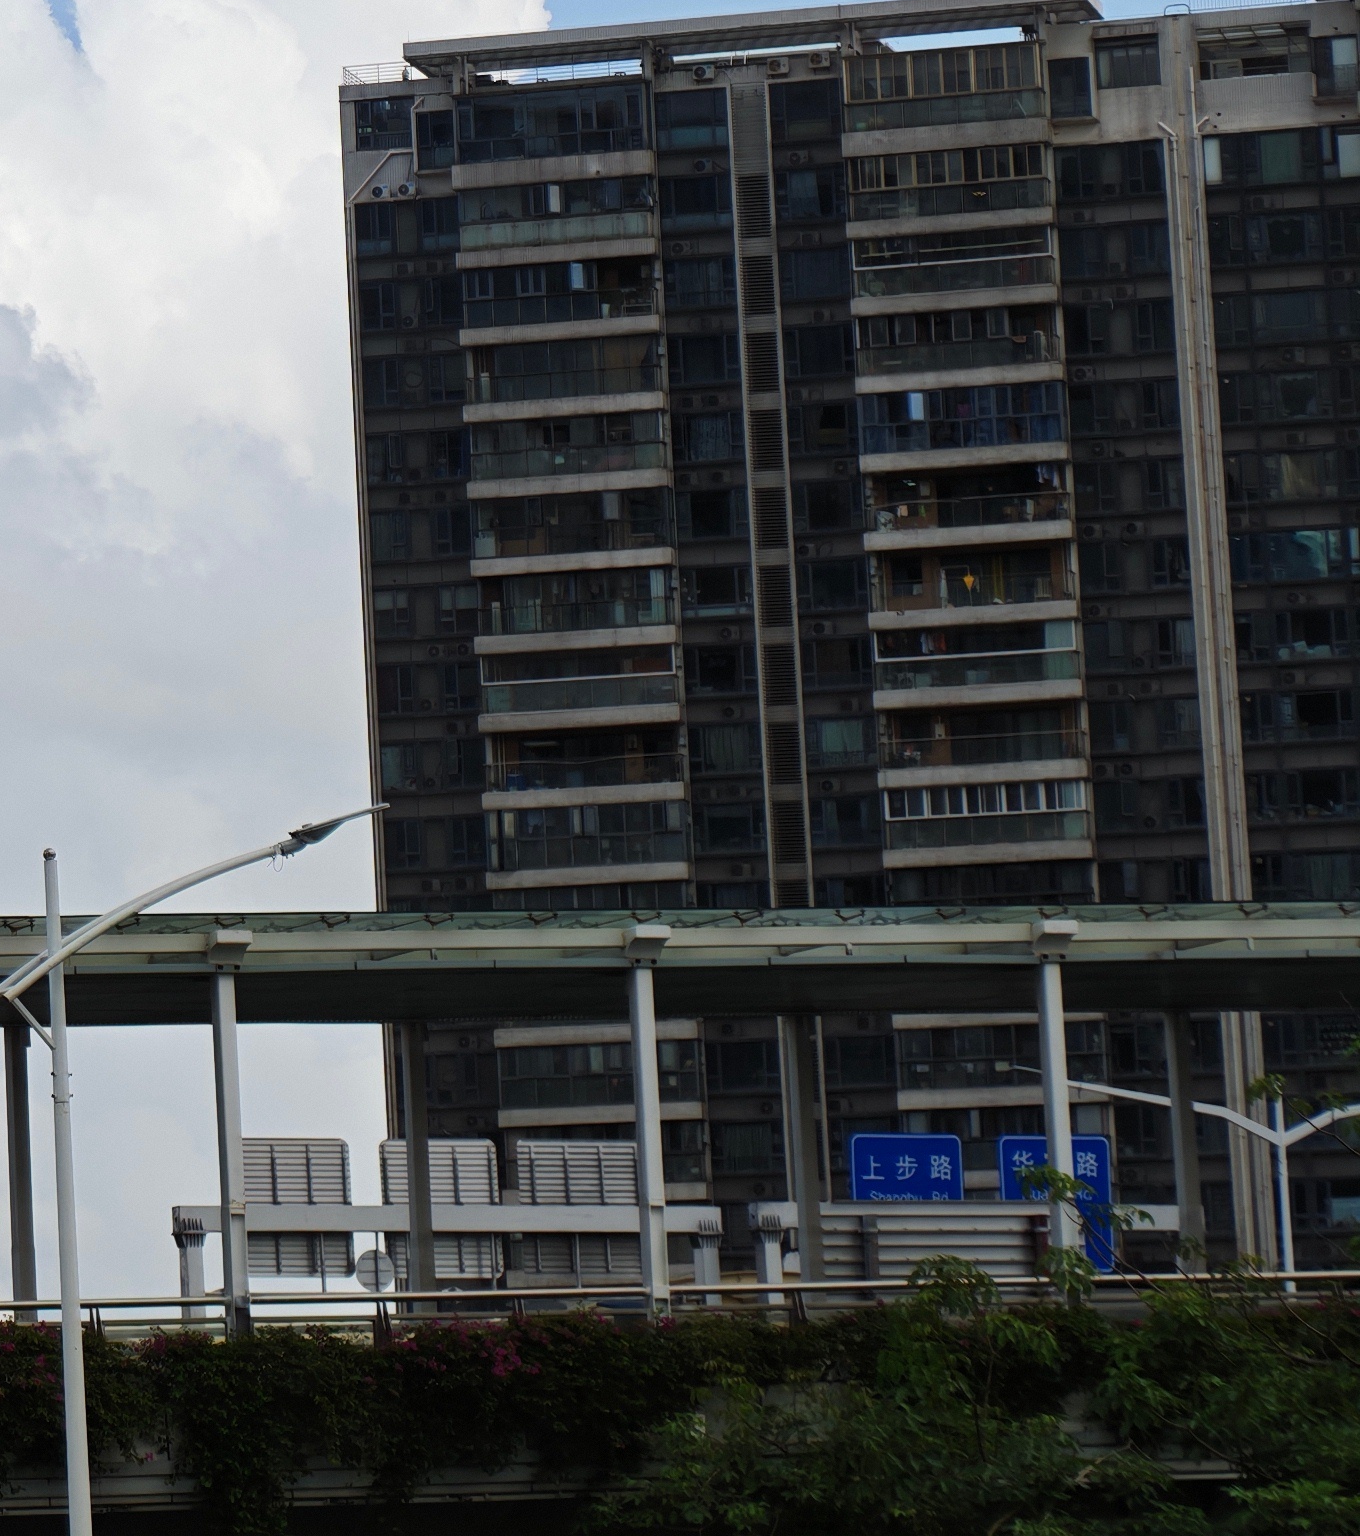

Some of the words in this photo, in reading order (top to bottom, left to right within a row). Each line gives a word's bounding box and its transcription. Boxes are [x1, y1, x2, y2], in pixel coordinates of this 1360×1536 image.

[860, 1154, 953, 1182] 上步路
[1011, 1149, 1099, 1178] 华路
